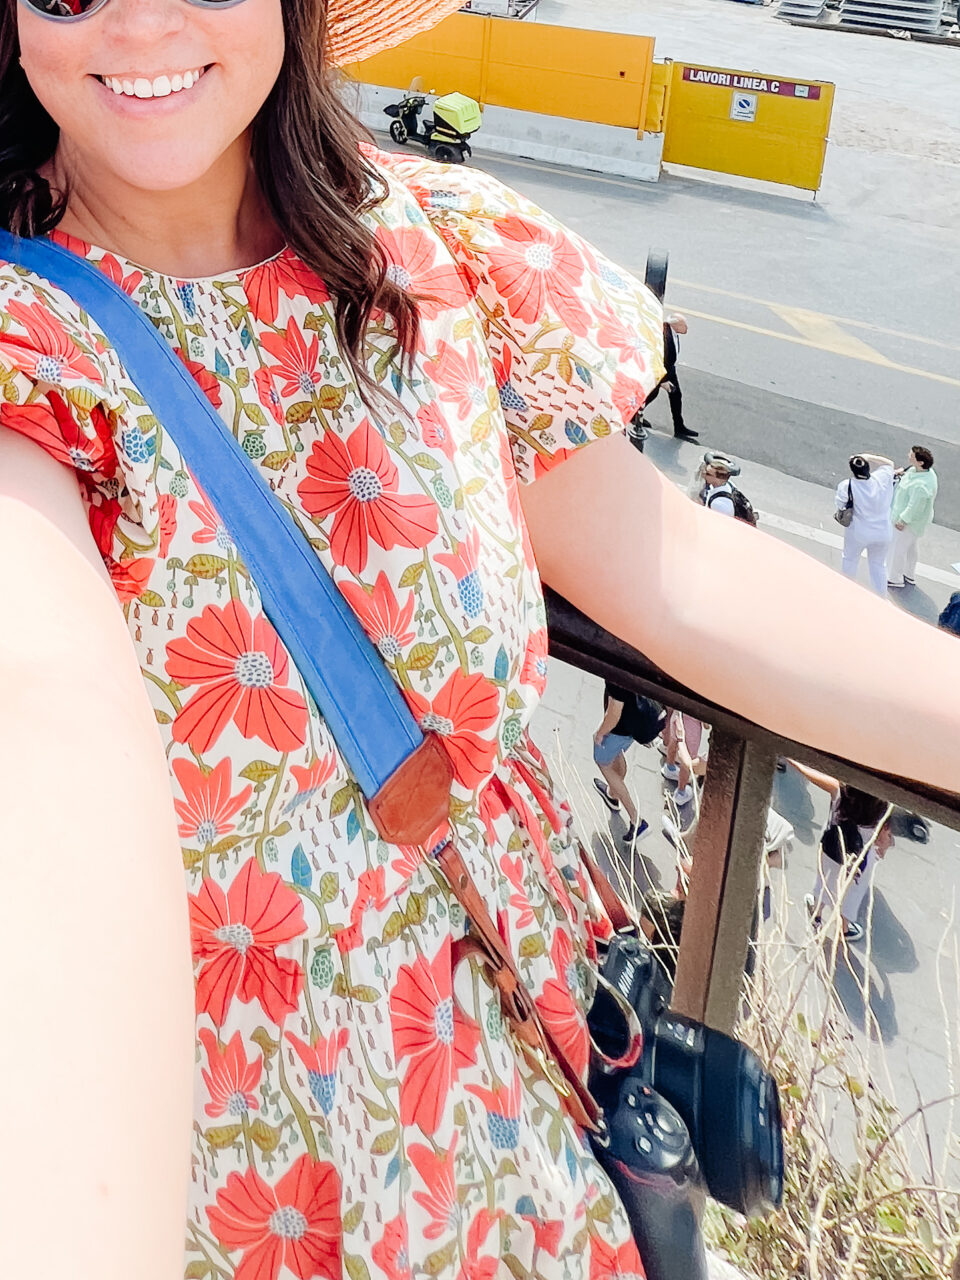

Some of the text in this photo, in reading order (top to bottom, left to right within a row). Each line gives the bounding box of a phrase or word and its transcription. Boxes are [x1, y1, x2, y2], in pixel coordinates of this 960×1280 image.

[689, 70, 780, 92] LAVORI LINEA C
